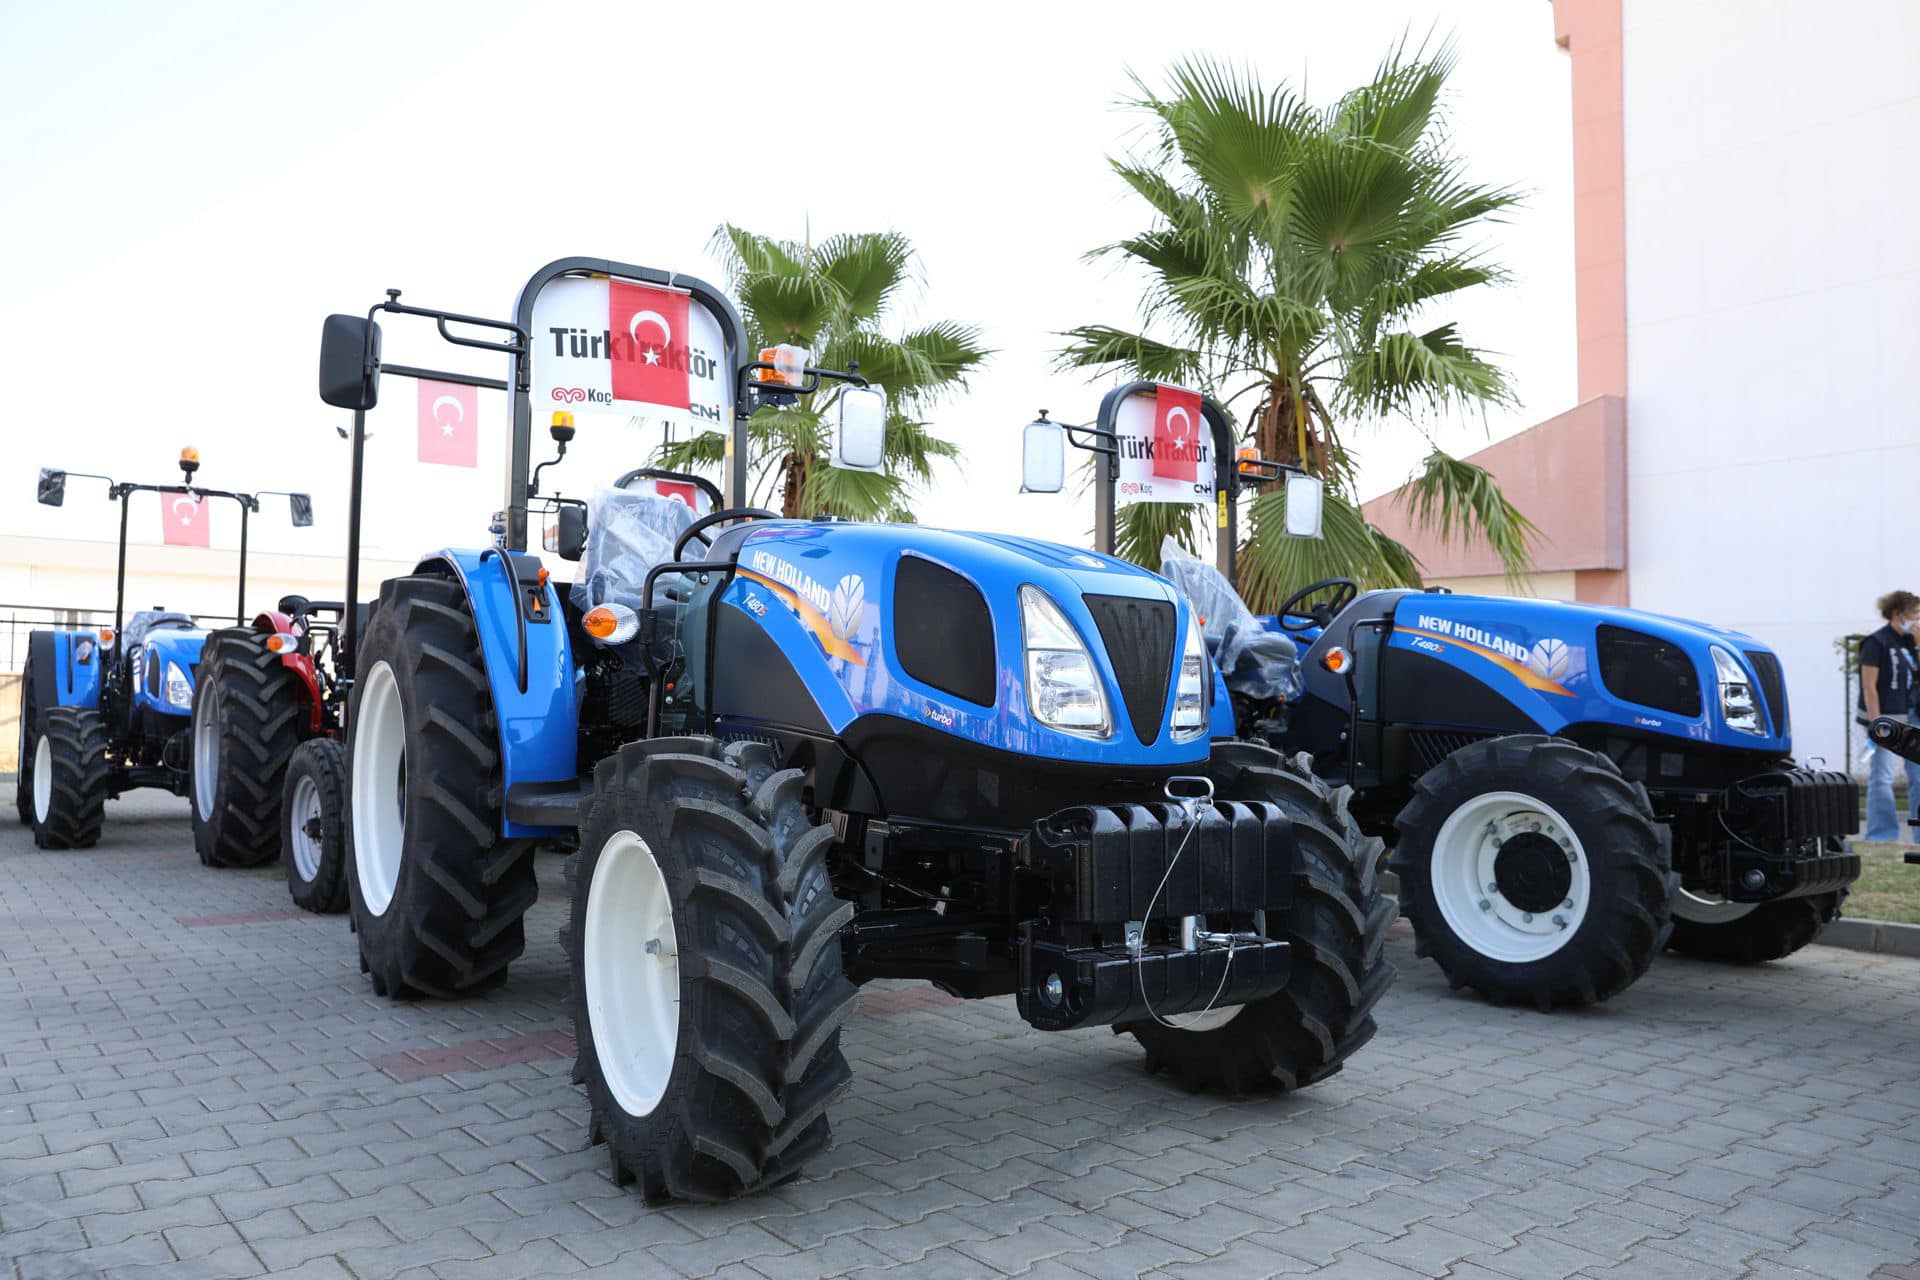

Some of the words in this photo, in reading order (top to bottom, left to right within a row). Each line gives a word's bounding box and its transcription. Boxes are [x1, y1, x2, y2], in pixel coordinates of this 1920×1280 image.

[588, 388, 612, 405] Koç
[752, 550, 774, 576] NEW
[776, 560, 831, 613] HOLLAND
[1418, 615, 1452, 634] NEW
[1454, 623, 1529, 662] HOLLAND
[931, 710, 952, 726] turbo
